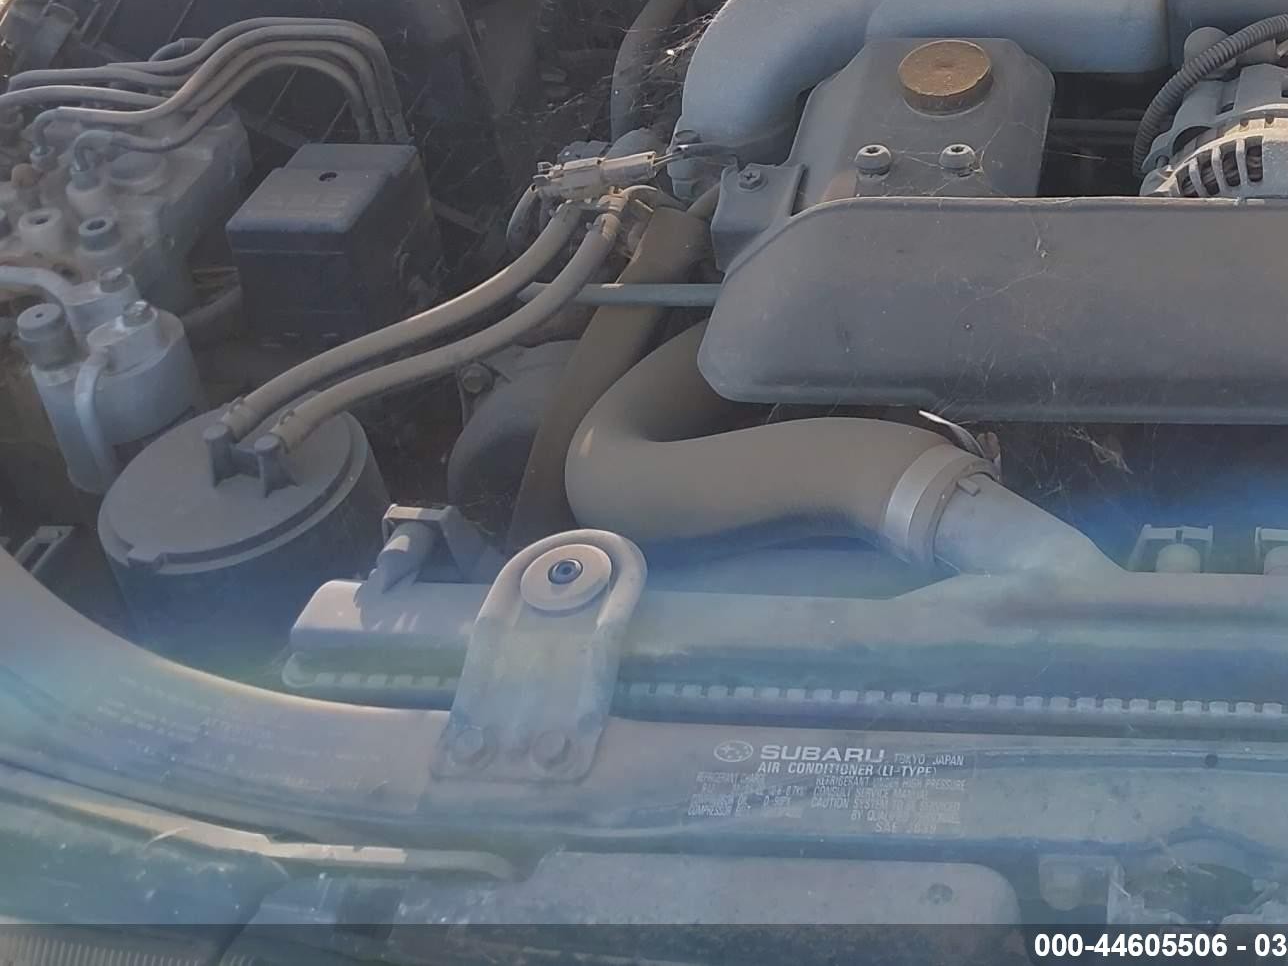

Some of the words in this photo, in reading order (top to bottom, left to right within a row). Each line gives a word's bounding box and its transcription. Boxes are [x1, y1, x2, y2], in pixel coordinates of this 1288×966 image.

[760, 744, 885, 763] SUBARU
[932, 753, 964, 766] JAPAN
[757, 761, 780, 773] AIR
[788, 762, 873, 776] CONDITIONER
